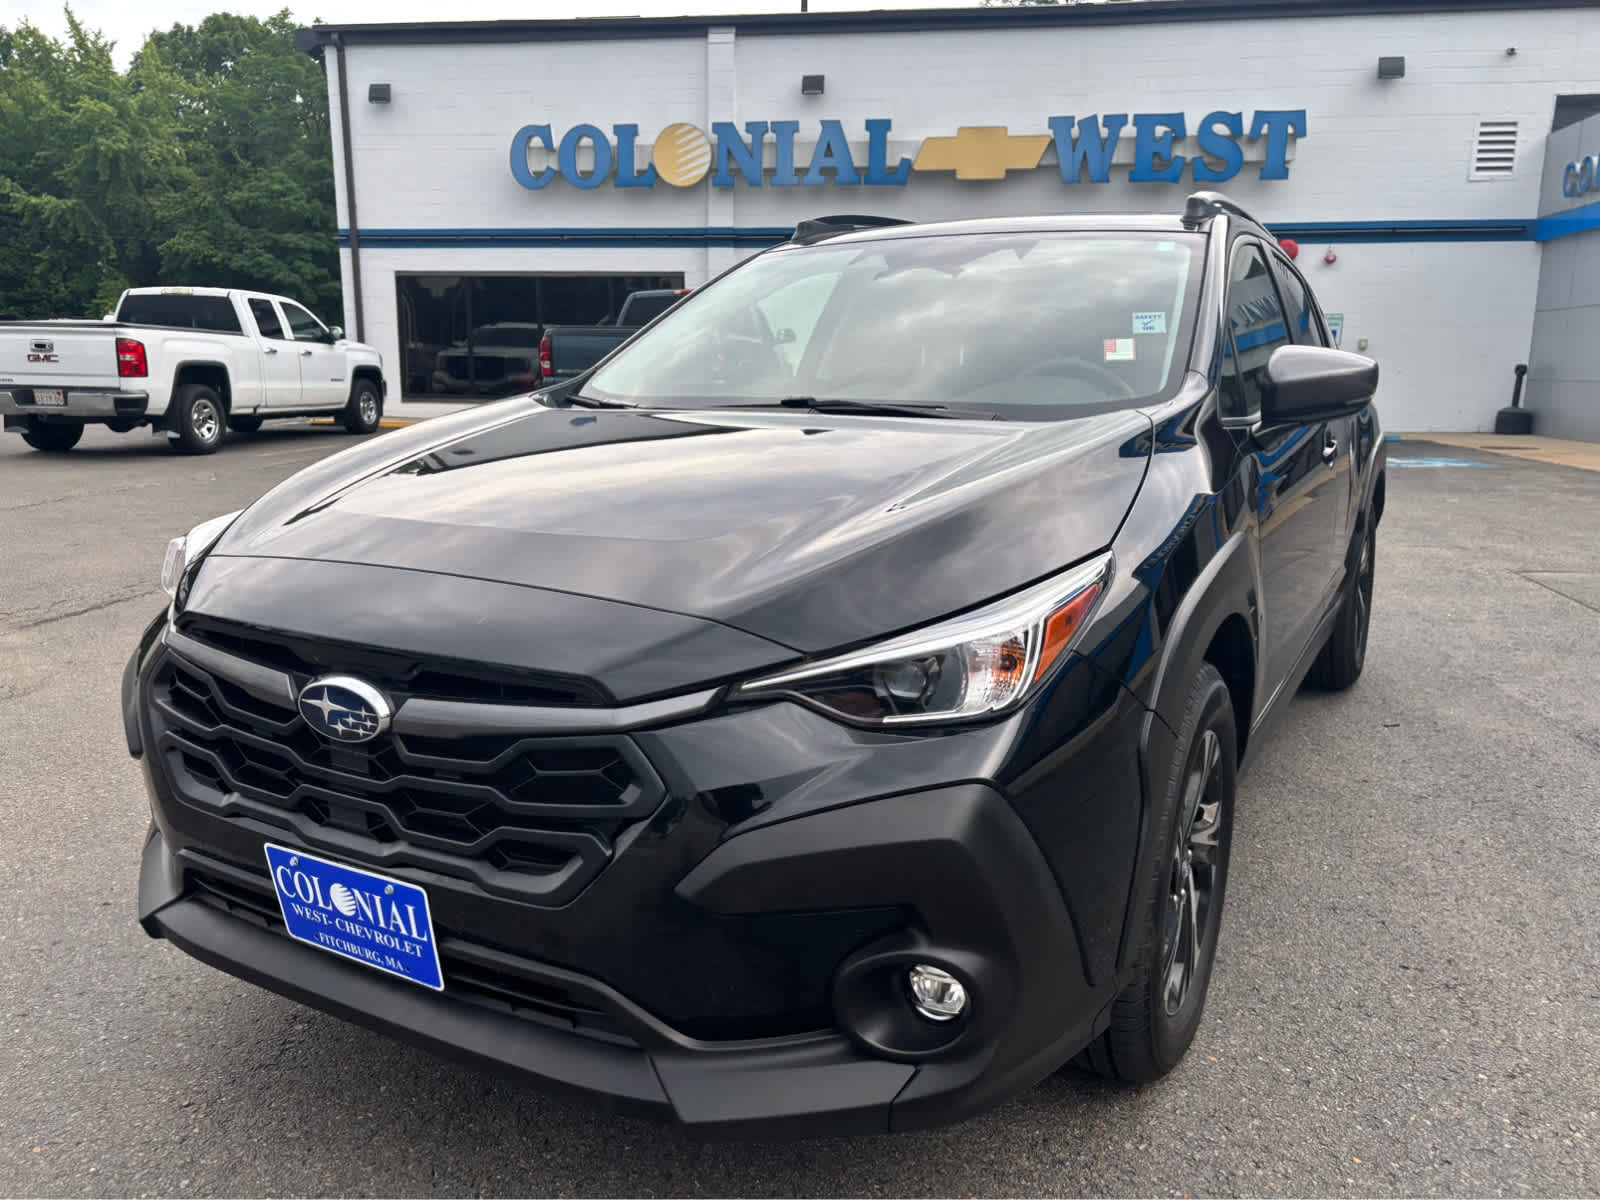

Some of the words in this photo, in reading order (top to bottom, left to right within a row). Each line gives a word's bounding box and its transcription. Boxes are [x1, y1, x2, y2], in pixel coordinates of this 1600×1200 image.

[509, 118, 911, 190] COLONIAL
[1047, 109, 1307, 184] WEST
[27, 354, 59, 362] GMC
[276, 865, 428, 942] COLONIAL
